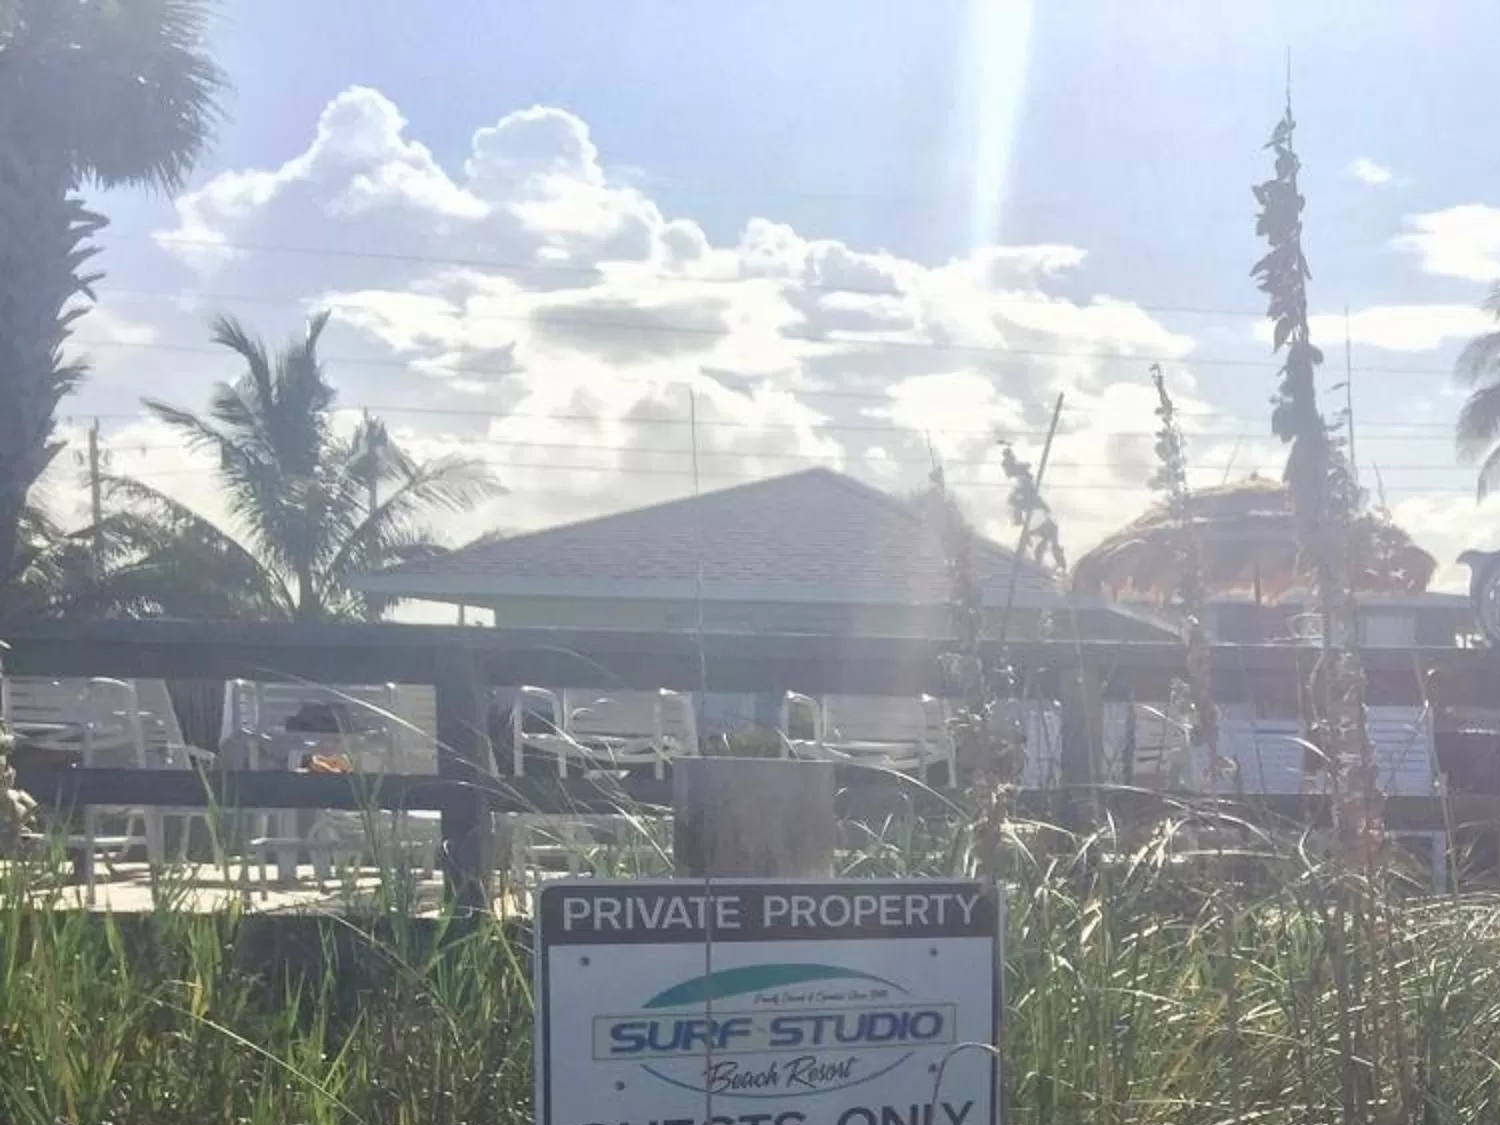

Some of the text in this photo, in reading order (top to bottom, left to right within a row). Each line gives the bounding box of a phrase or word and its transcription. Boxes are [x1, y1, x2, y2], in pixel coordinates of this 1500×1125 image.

[562, 894, 979, 931] PRIVATE PROPERTY
[609, 1010, 944, 1054] SURF STUDIO
[705, 1056, 859, 1094] Beach Resort
